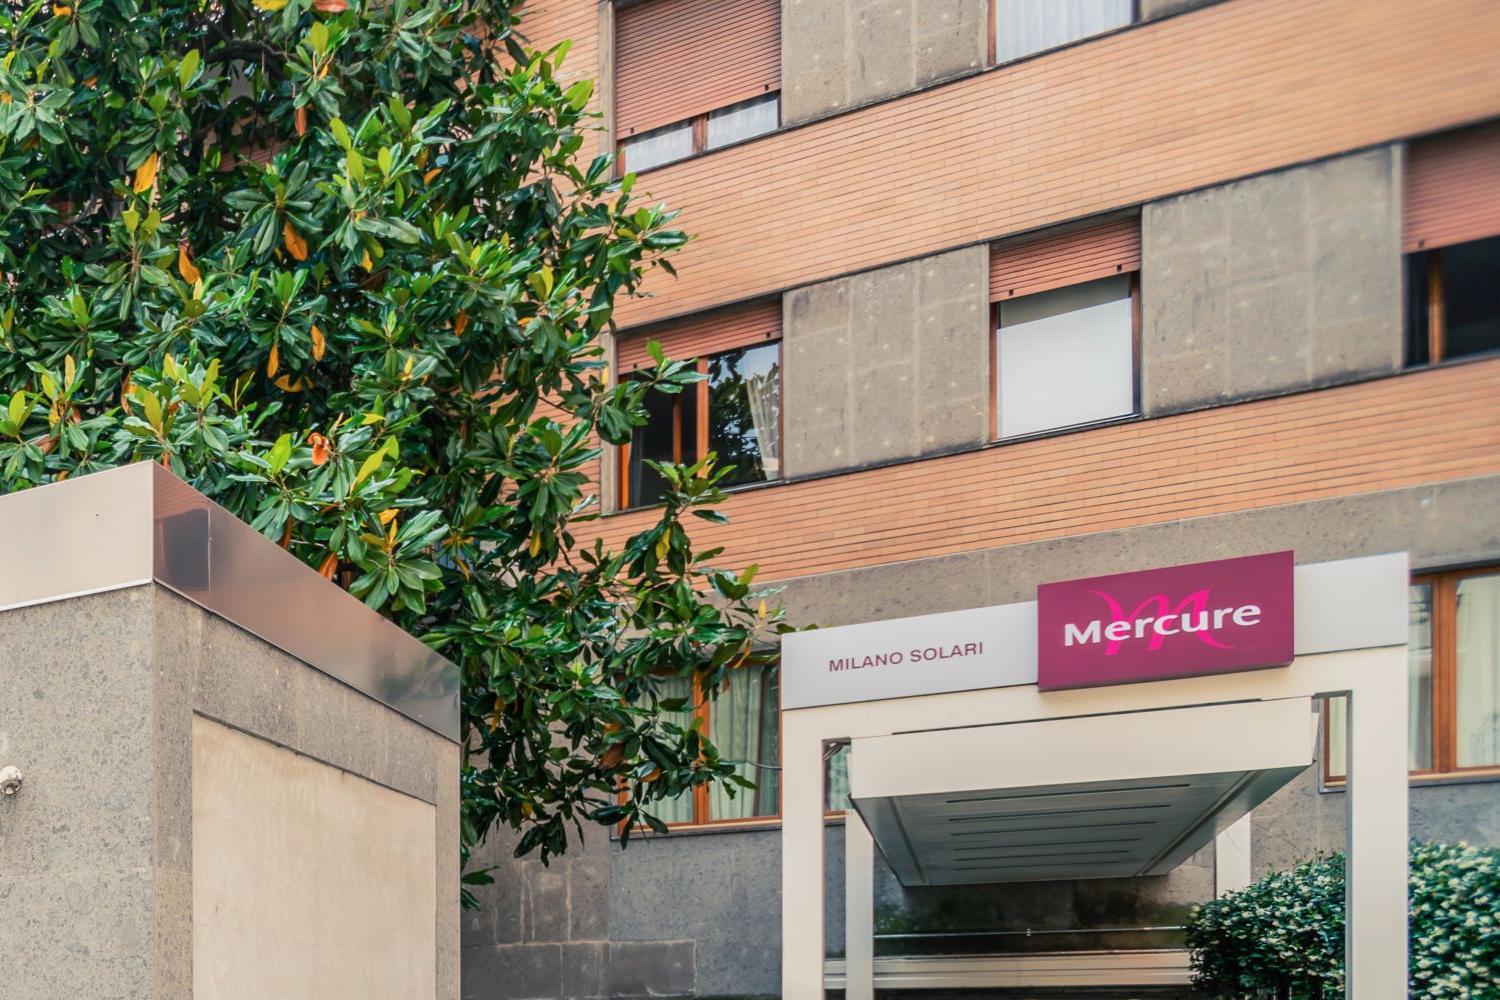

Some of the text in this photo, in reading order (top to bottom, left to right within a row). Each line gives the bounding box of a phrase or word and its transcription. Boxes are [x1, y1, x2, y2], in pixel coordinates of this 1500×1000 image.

[1063, 604, 1262, 648] Mercure
[828, 641, 985, 673] MILANO SOLARI
